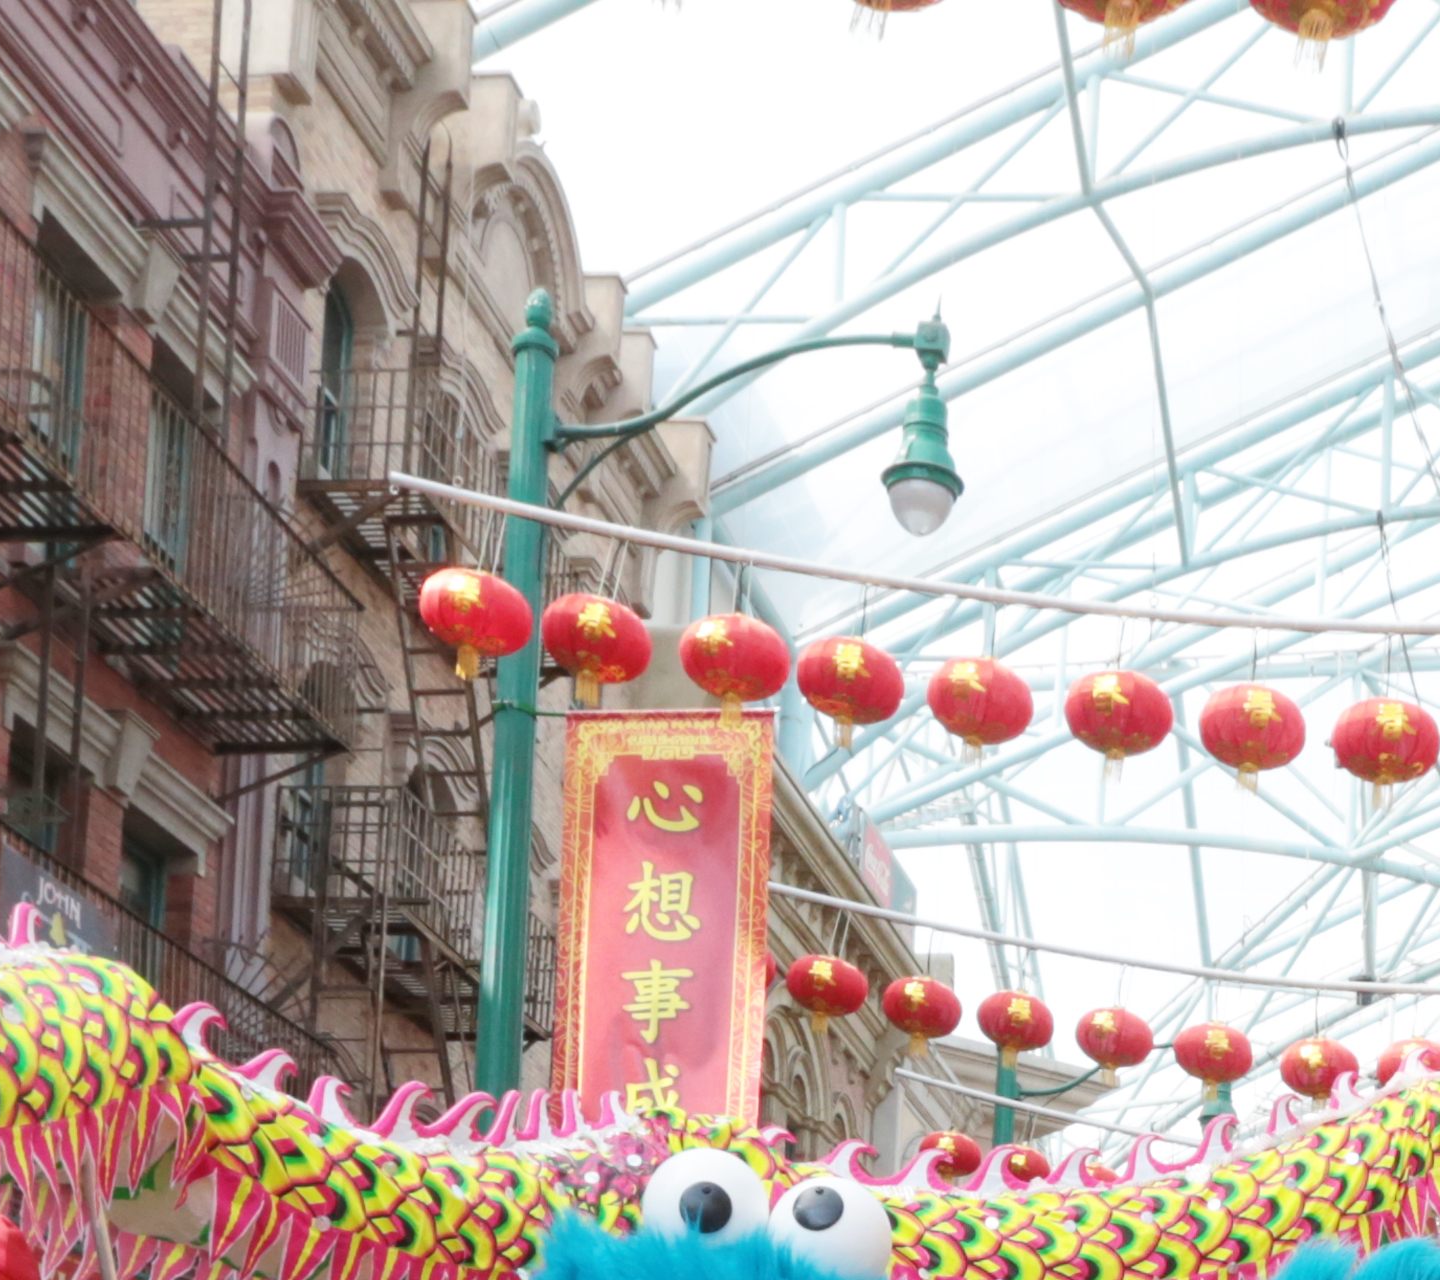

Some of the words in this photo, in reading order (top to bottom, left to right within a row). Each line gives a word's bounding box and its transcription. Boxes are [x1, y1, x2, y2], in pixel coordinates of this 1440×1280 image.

[1373, 703, 1416, 741] 春
[36, 876, 82, 929] JOHN
[622, 780, 703, 1116] 心想事成
